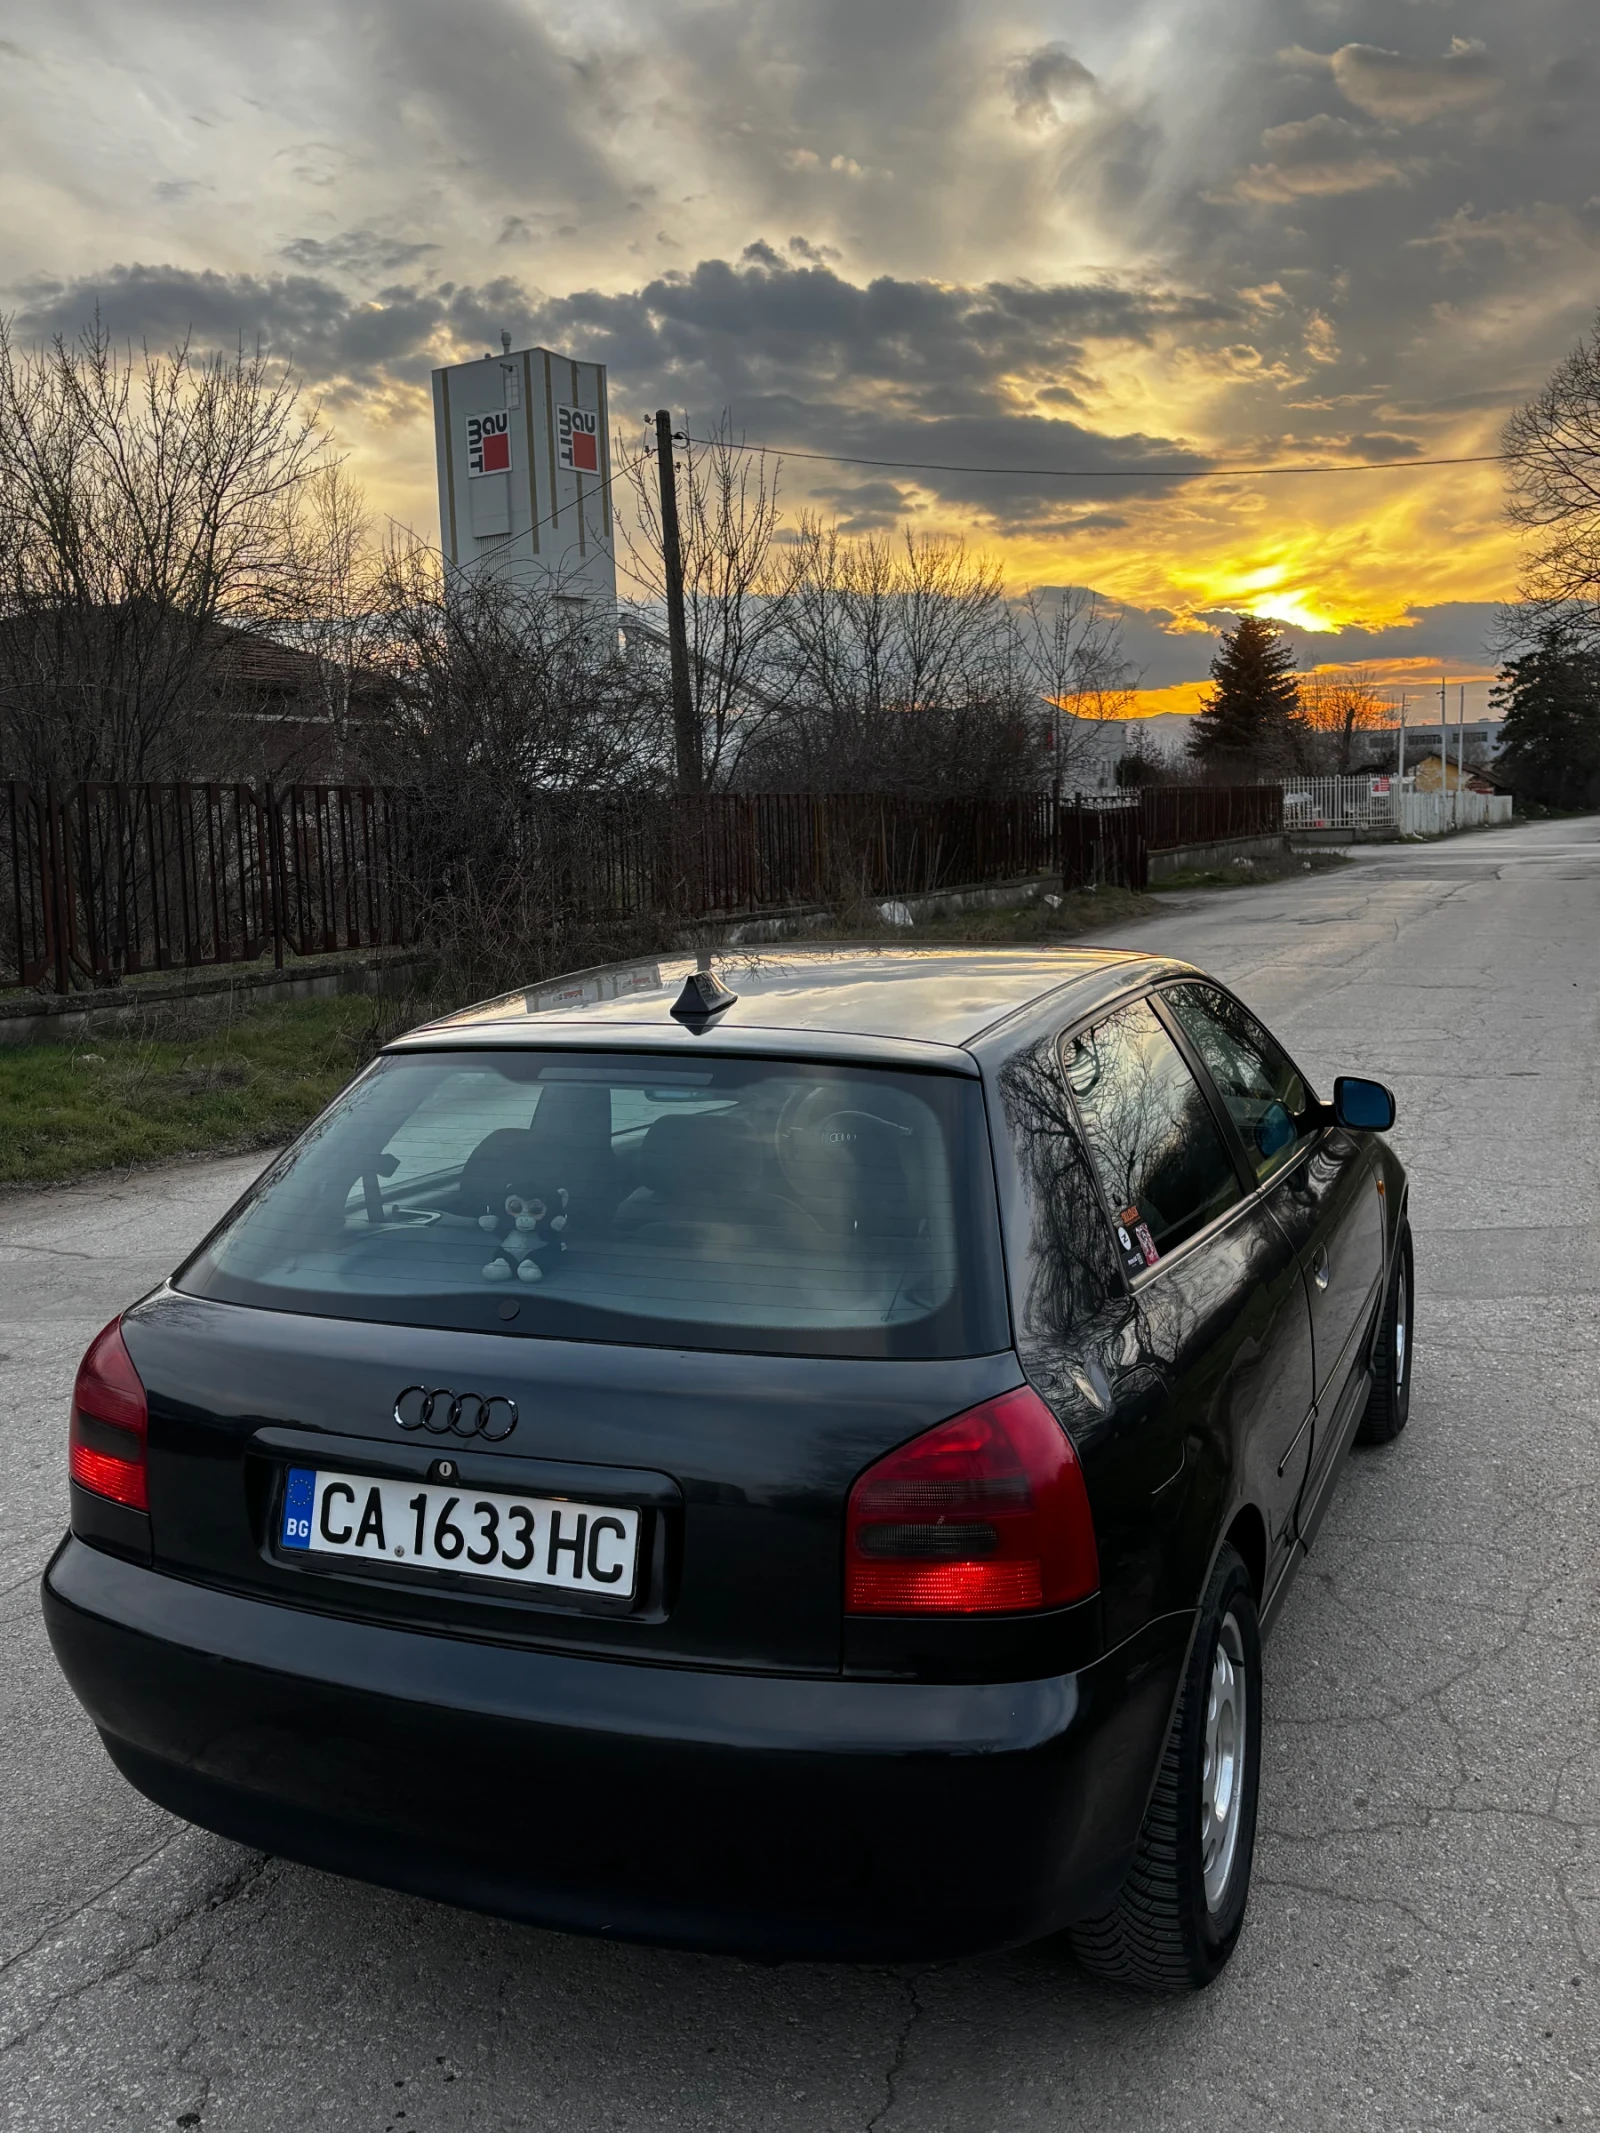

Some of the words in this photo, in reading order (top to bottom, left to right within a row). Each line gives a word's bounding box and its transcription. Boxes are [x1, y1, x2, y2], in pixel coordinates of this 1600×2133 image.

[286, 1518, 309, 1538] BG
[320, 1482, 386, 1550] CA
[409, 1493, 535, 1570] 1633
[547, 1510, 626, 1583] HC
